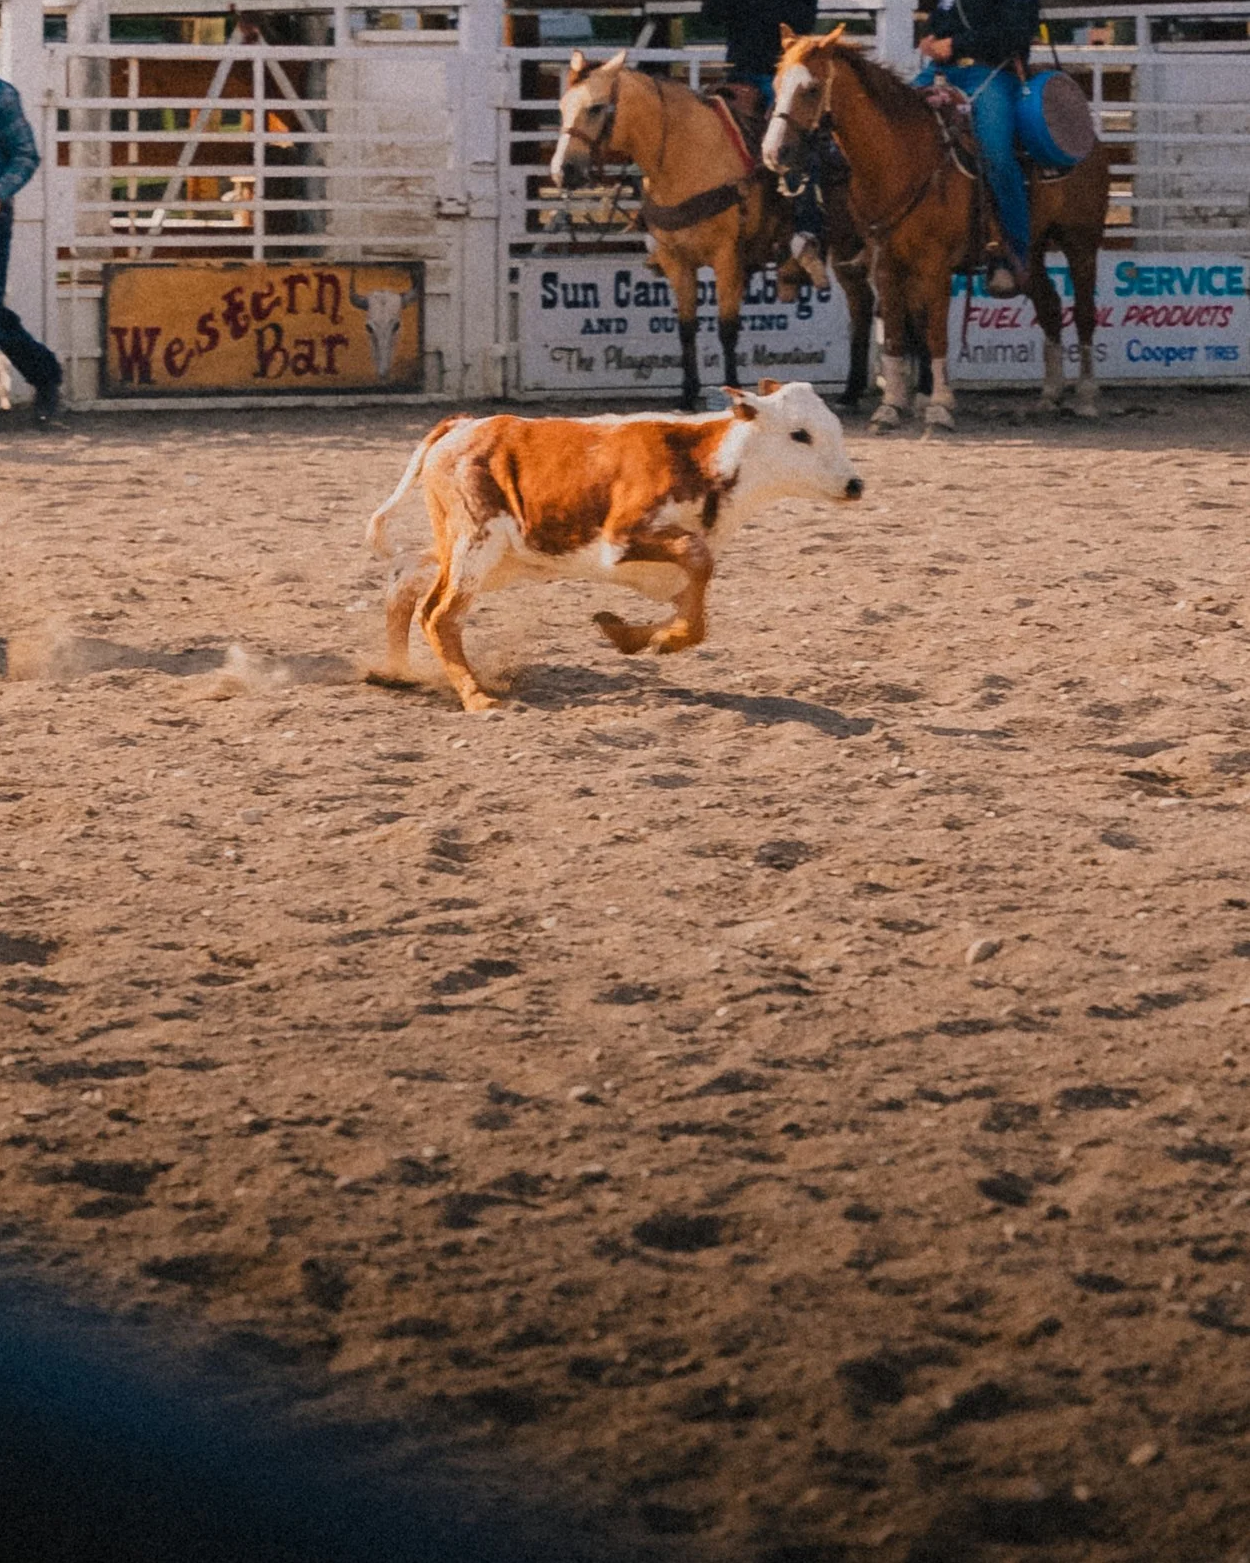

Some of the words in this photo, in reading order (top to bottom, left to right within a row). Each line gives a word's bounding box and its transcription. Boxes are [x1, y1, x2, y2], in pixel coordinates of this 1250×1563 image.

[541, 272, 599, 309] Sun
[744, 269, 831, 320] Loge
[1115, 261, 1244, 297] SERVICE
[110, 272, 344, 384] Western
[581, 318, 627, 335] AND
[966, 306, 1021, 329] FUEL
[1122, 305, 1234, 328] PRODUCTS
[253, 323, 349, 379] Bar
[957, 340, 1036, 363] Animal
[1126, 339, 1197, 366] Cooper
[1204, 345, 1239, 361] TIRES
